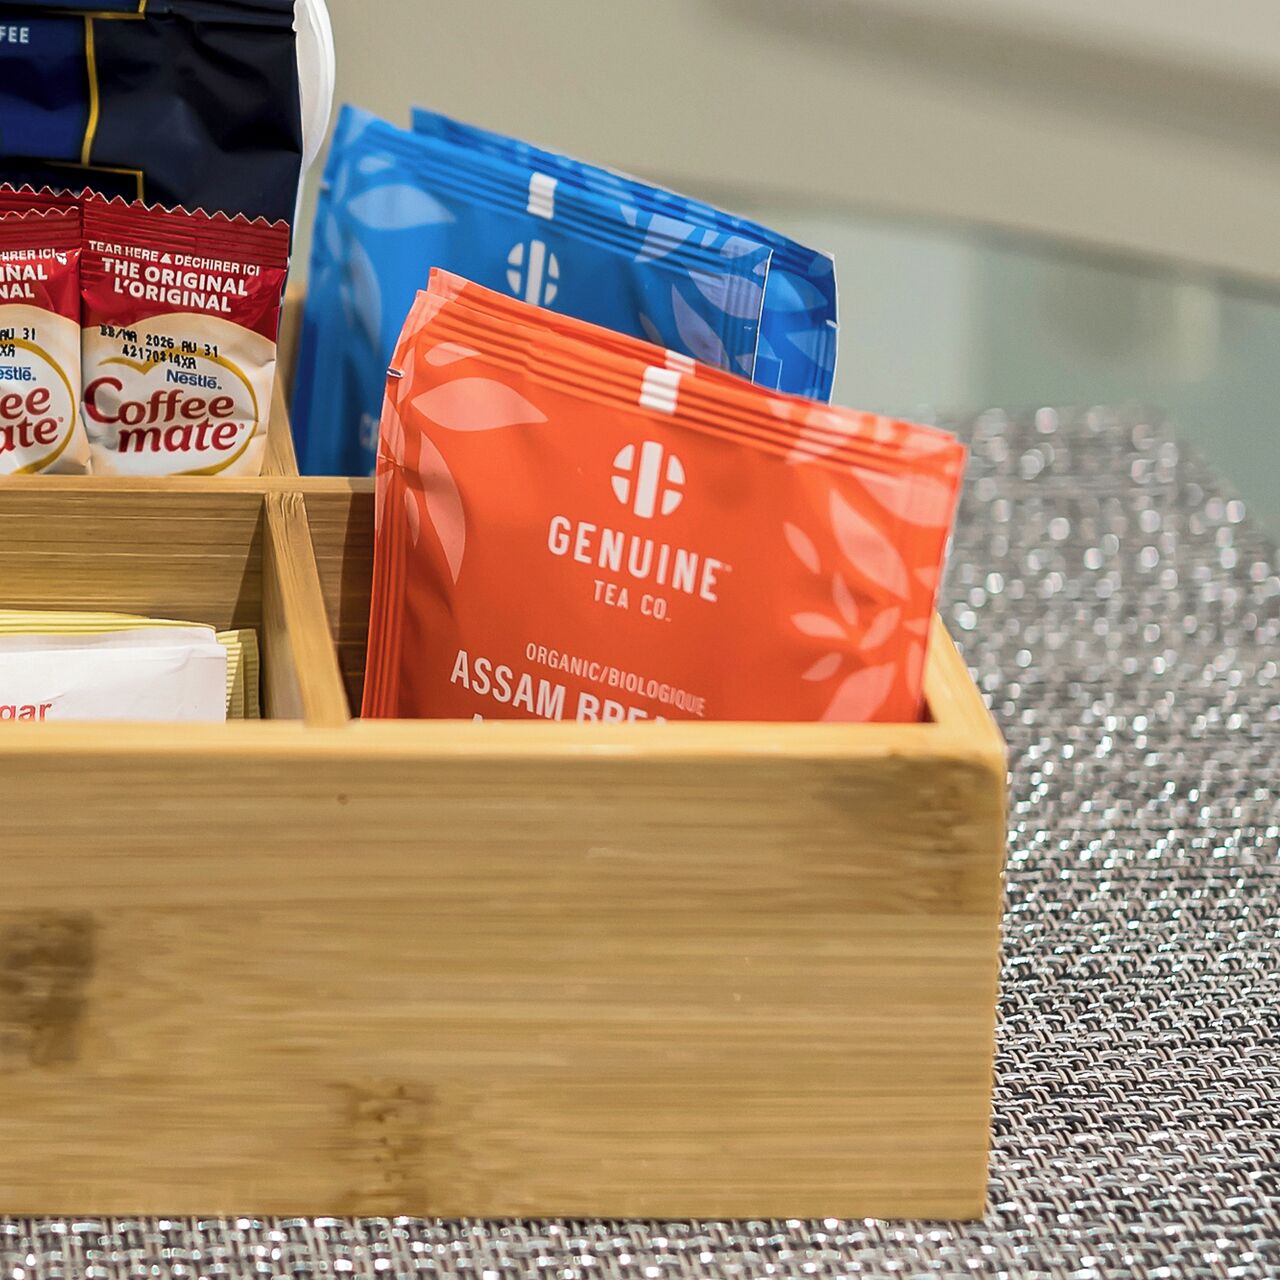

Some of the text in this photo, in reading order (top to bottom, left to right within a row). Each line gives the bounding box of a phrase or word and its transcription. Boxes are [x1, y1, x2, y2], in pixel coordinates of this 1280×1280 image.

[39, 248, 56, 260] ICI
[89, 240, 122, 255] TEAR
[125, 247, 159, 262] HERE
[243, 264, 260, 277] ICI
[101, 257, 248, 296] THE ORIGINAL
[114, 277, 231, 312] L'ORIGINAL
[0, 328, 14, 340] AU
[23, 327, 36, 340] 31
[146, 334, 174, 349] 2026
[182, 340, 197, 353] AU
[204, 344, 218, 358] 31
[84, 376, 234, 425] Coffee
[118, 417, 238, 453] mate
[594, 579, 672, 623] TEA CO.
[450, 649, 566, 721] ASSAM
[526, 642, 706, 717] ORGANIC/BIOLOGIQUE
